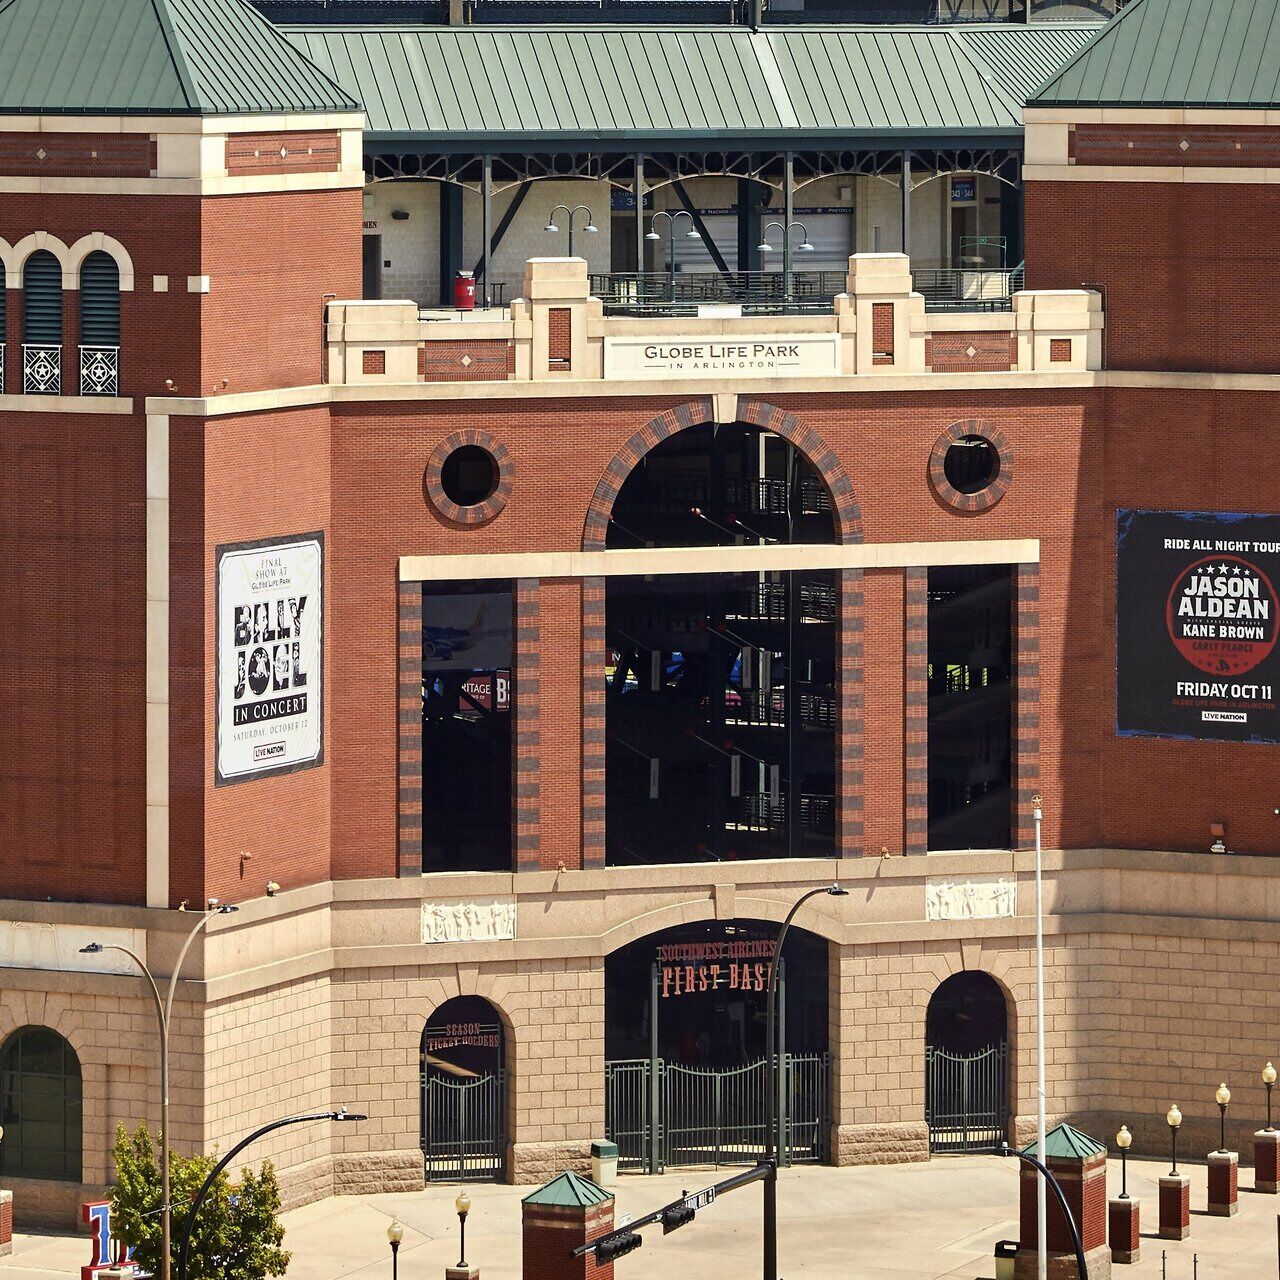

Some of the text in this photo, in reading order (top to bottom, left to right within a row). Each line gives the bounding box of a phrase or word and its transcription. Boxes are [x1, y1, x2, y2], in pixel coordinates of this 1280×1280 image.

[644, 344, 800, 359] GLOBE LIFE PARK
[693, 361, 775, 369] ARLINGTON
[1164, 538, 1190, 550] RIDE
[1192, 540, 1213, 551] ALL
[1215, 540, 1251, 552] NIGHT
[261, 558, 281, 569] FINAL
[256, 569, 276, 580] SHOW
[1184, 575, 1259, 598] JASON
[1178, 596, 1269, 620] ALDEAN
[234, 595, 308, 647] BILLY
[1183, 623, 1264, 639] KANE BROWN
[233, 641, 307, 699] JOEL
[461, 683, 491, 695] RITAGE
[1231, 684, 1258, 699] OCT
[1261, 685, 1272, 699] 11
[235, 696, 306, 722] IN CONCERT
[269, 722, 299, 734] OCTOBER
[255, 745, 284, 757] LIVE NATION
[662, 940, 775, 961] SOUTHWEST AIRLINES
[662, 962, 777, 998] FIRST BAS
[446, 1023, 480, 1036] SEASON
[462, 1034, 499, 1047] HOLDERS
